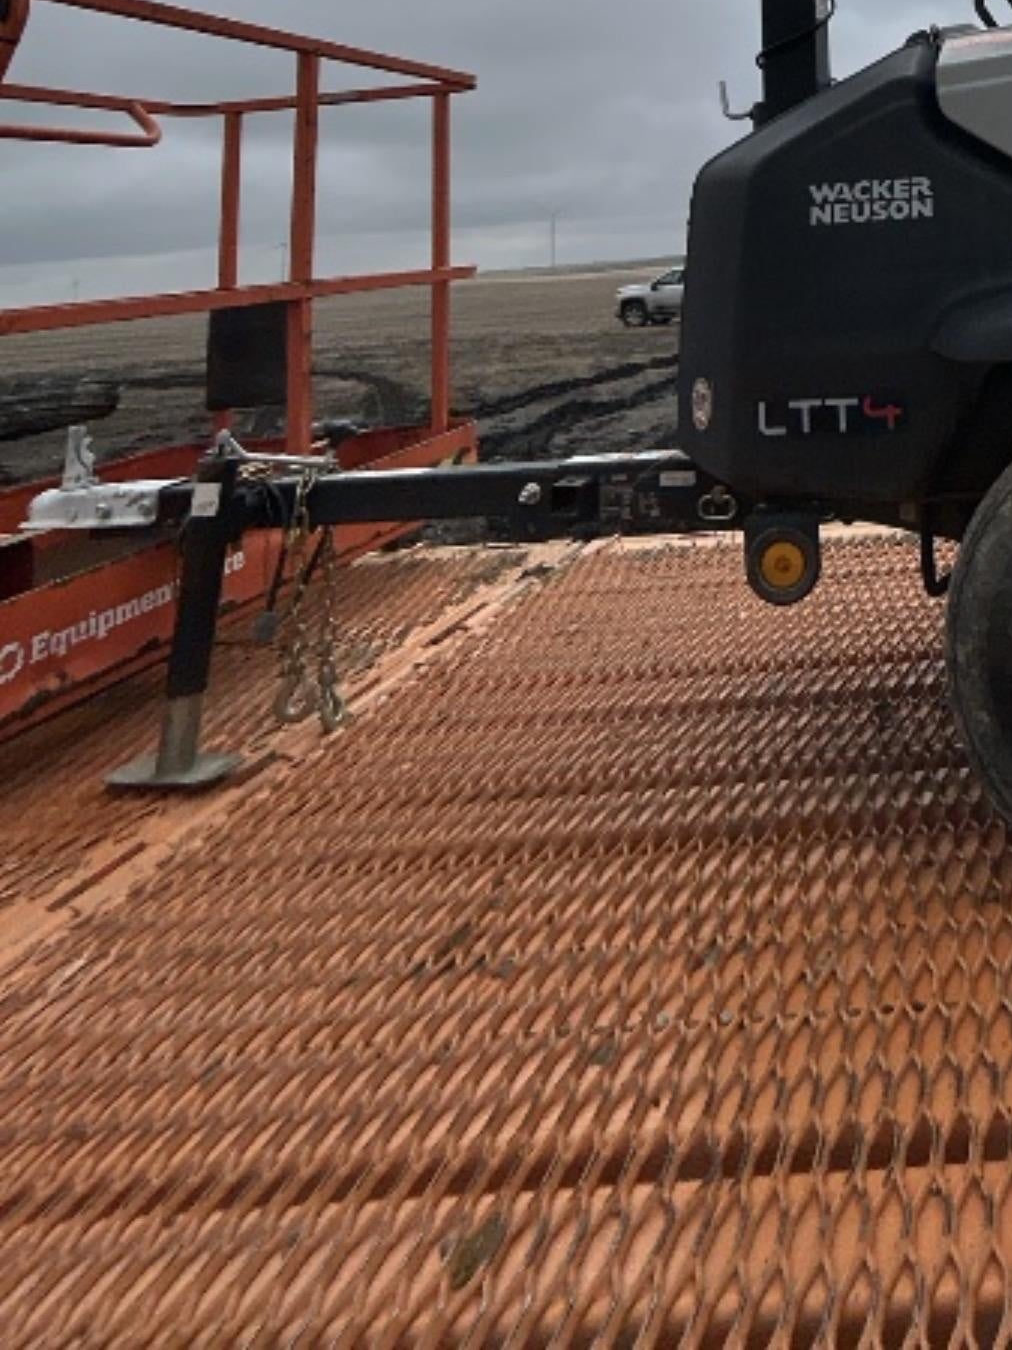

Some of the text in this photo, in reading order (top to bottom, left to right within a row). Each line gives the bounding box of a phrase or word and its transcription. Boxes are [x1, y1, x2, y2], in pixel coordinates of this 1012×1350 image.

[809, 176, 934, 204] WACKER
[809, 197, 934, 226] NEUSON
[758, 395, 904, 436] LTT4
